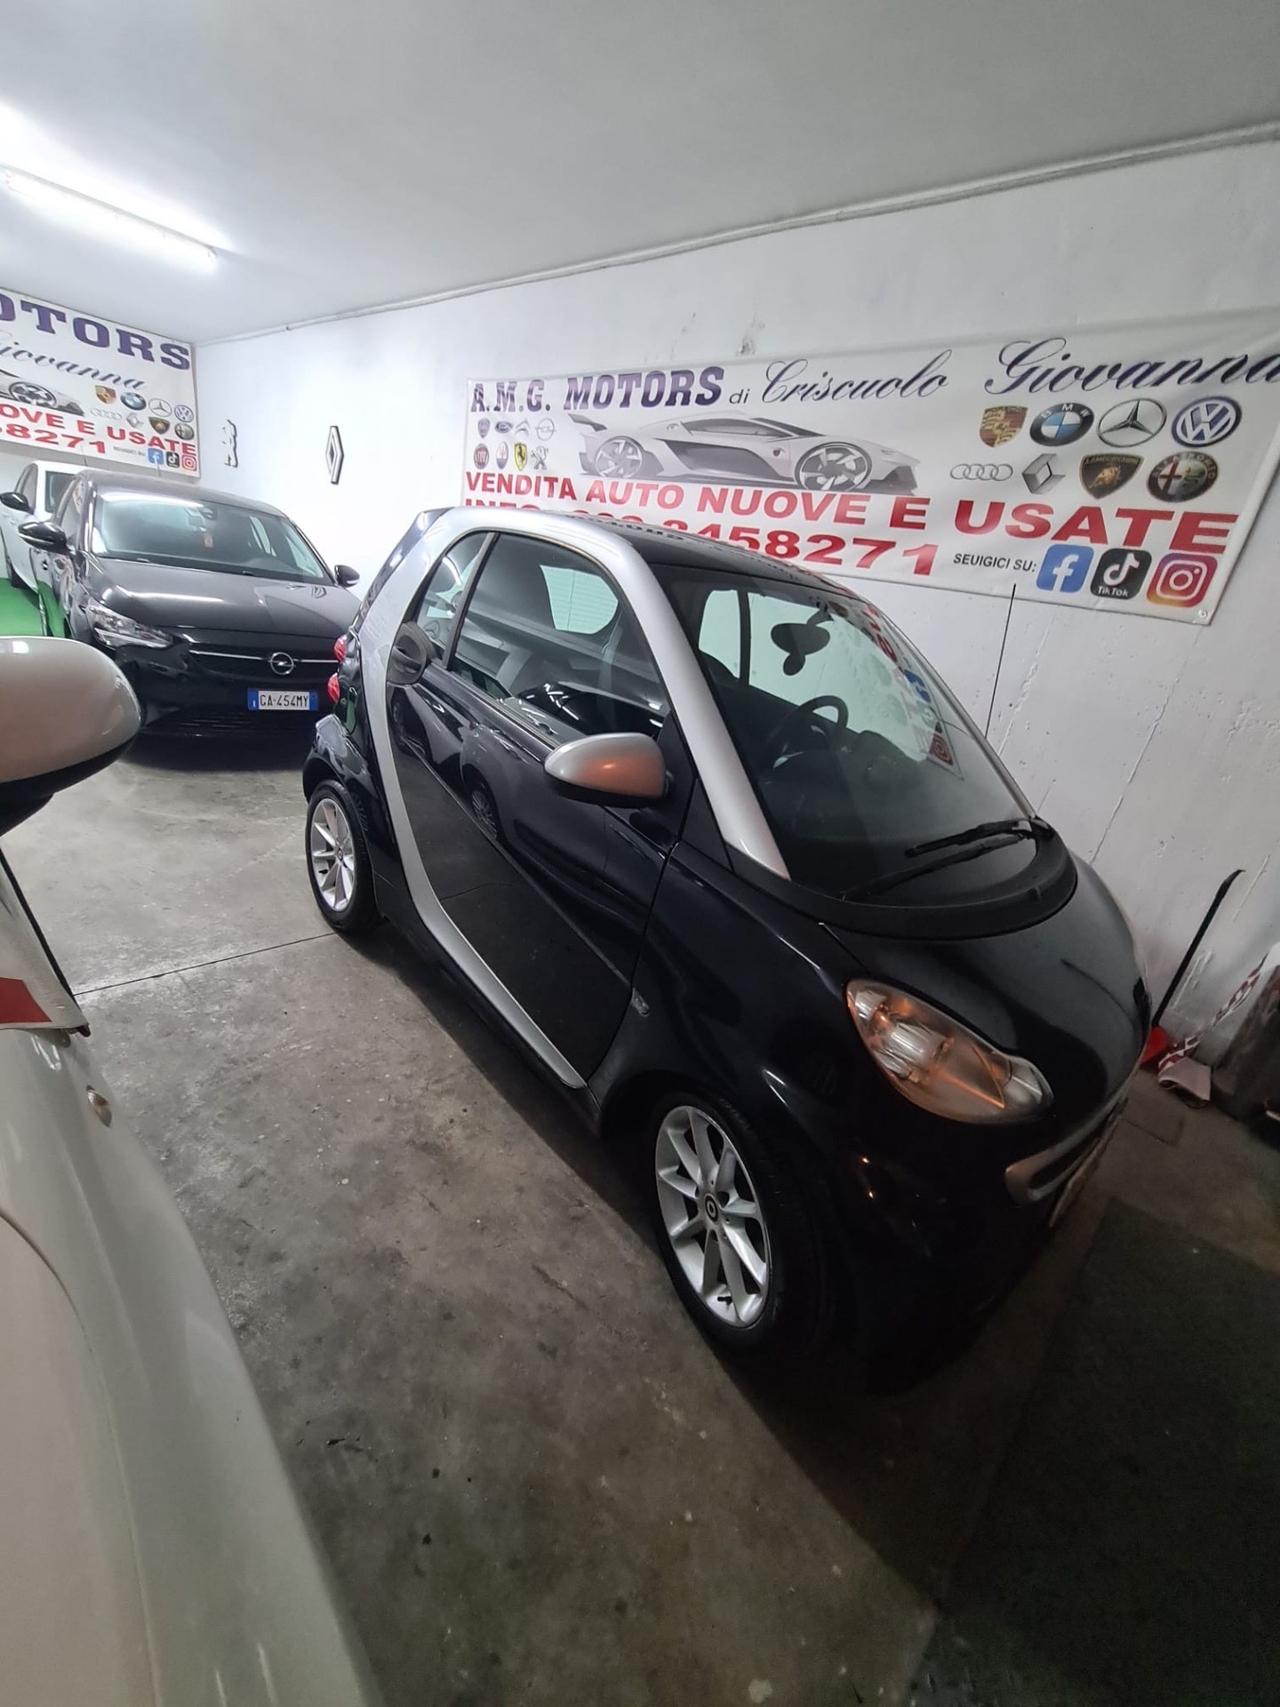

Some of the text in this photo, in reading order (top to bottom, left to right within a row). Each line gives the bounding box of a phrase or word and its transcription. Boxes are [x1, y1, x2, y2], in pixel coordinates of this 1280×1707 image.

[0, 332, 145, 390] iovanna
[563, 366, 725, 411] MOTORS
[729, 388, 750, 405] di
[761, 349, 952, 404] Criscuolo
[0, 424, 105, 454] 8271
[77, 420, 96, 436] E
[107, 426, 197, 457] USATE
[466, 471, 1240, 554] VENDITA AUTO NUOVE E USATE
[953, 552, 1037, 573] SEUIGICI SU:
